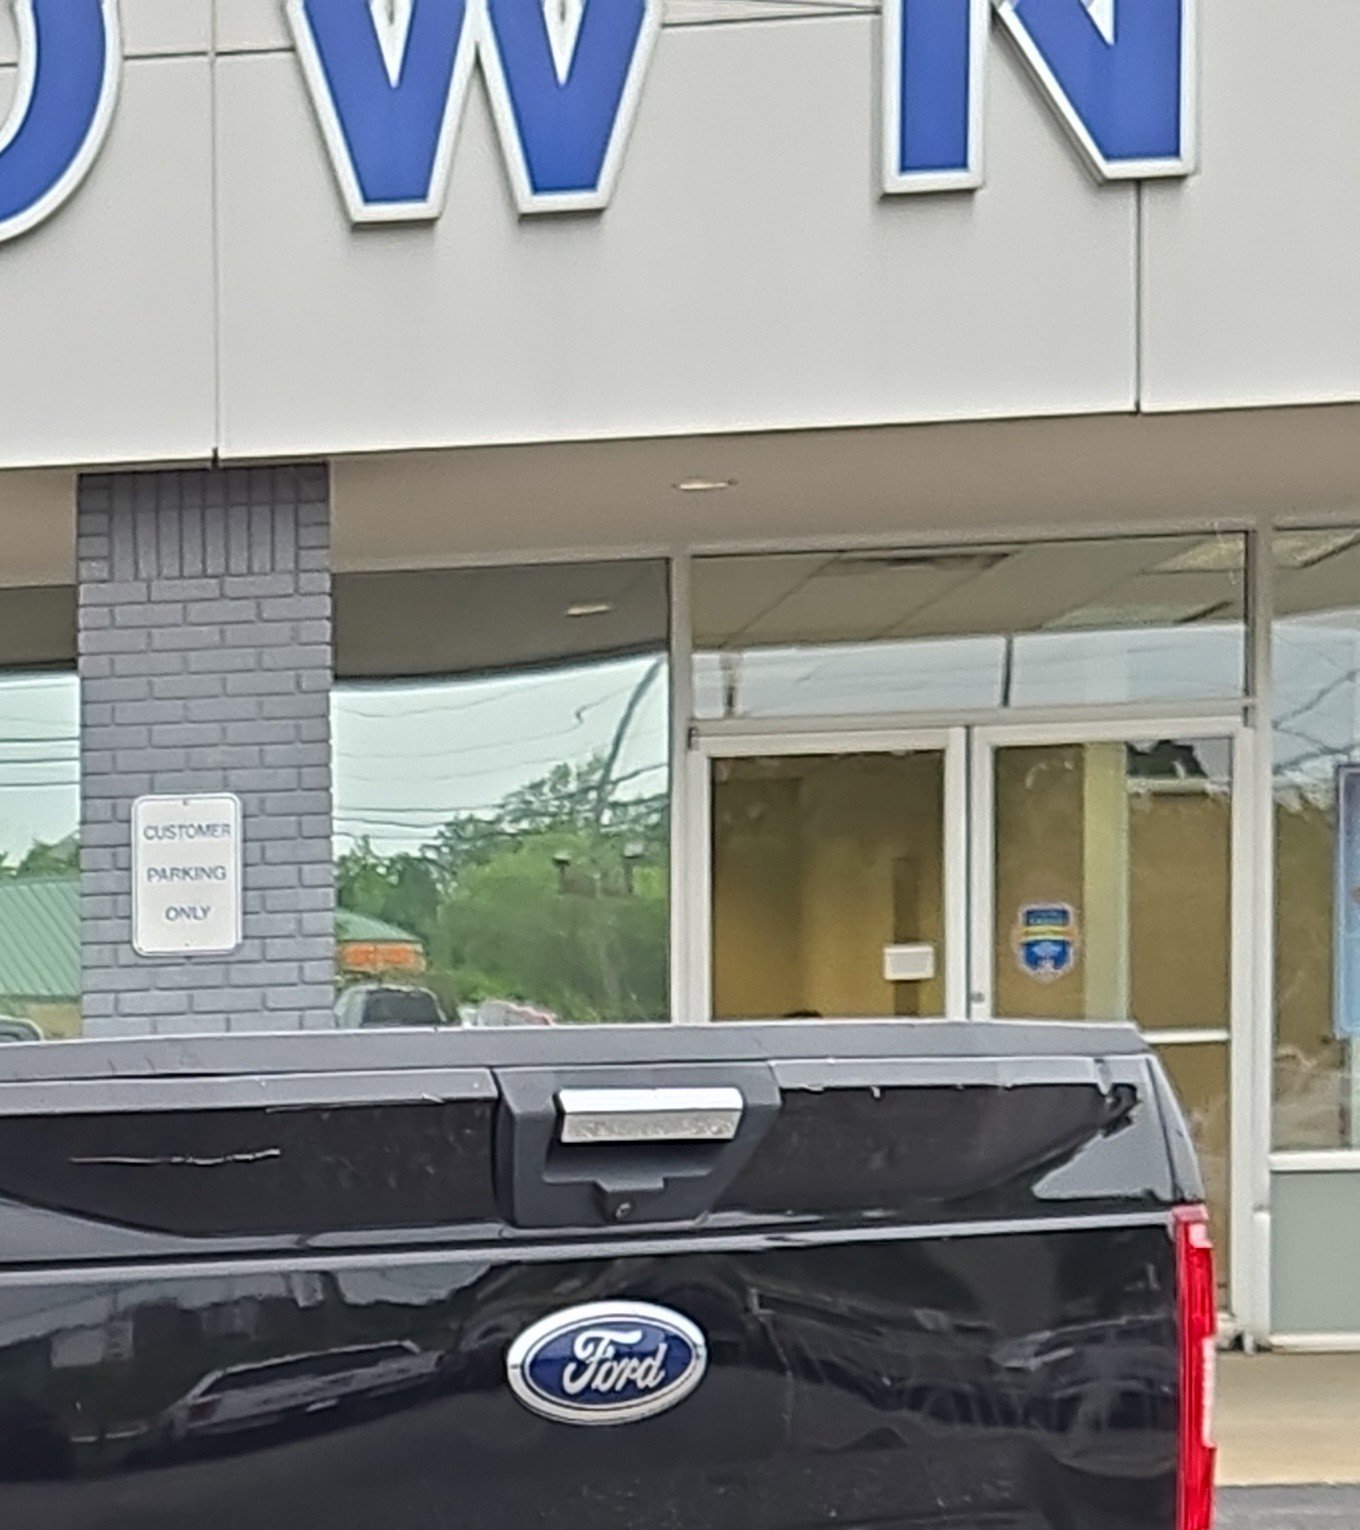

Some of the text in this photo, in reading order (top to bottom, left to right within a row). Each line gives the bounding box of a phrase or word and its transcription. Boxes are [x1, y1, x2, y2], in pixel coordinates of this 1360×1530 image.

[143, 823, 232, 840] CUSTOMER
[147, 865, 226, 881] PARKING
[165, 905, 211, 921] ONLY
[562, 1329, 669, 1395] Ford
